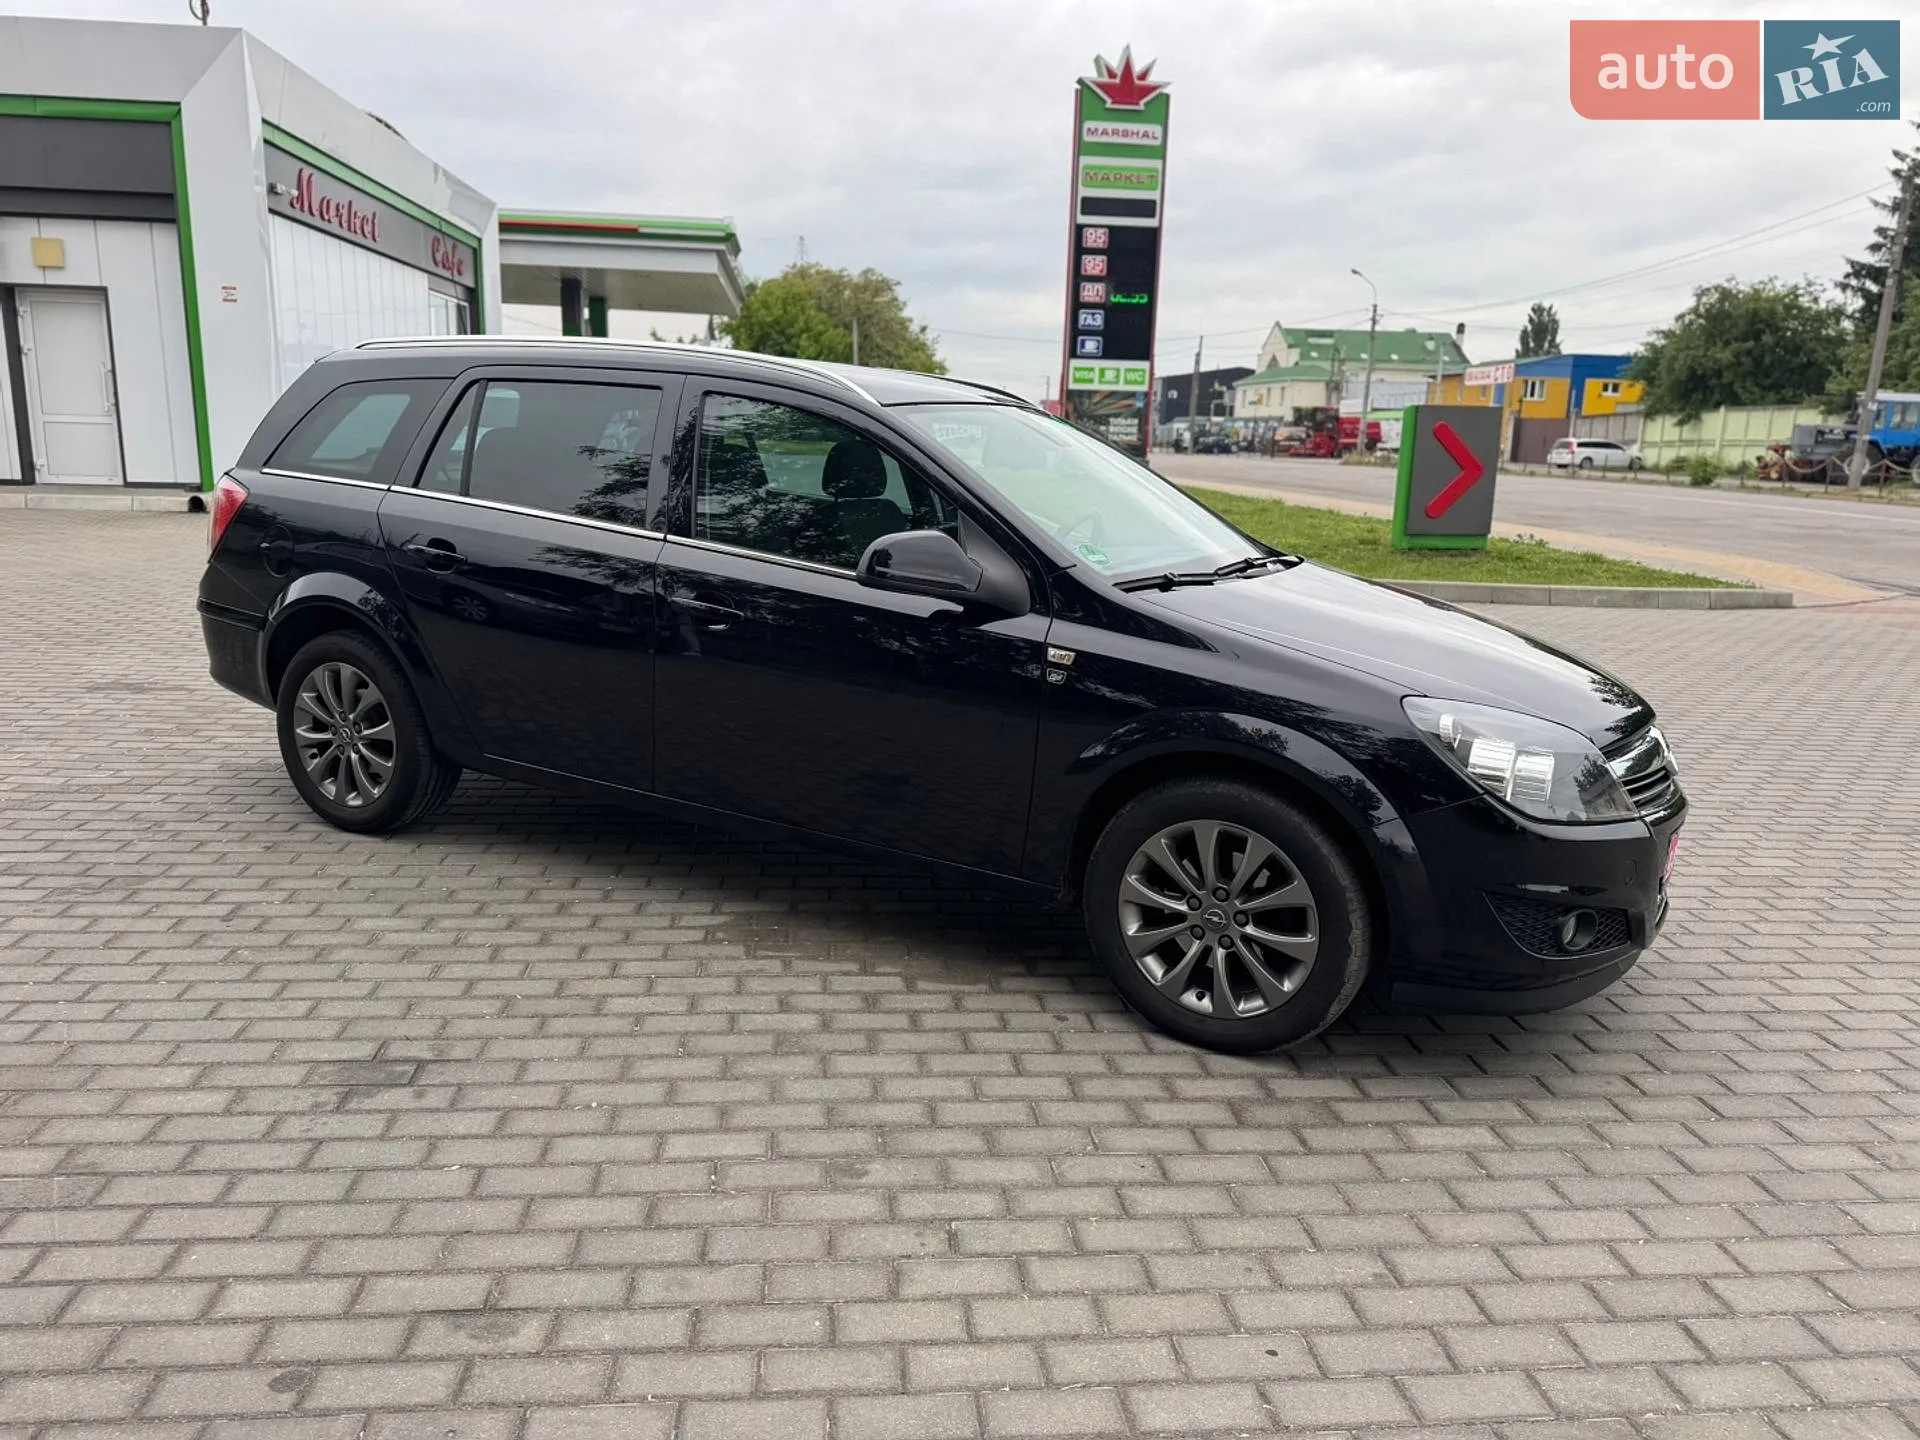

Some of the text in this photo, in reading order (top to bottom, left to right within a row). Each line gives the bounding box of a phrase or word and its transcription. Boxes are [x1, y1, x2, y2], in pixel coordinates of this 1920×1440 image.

[1086, 126, 1159, 140] MARSHAL
[289, 168, 381, 243] Market
[1086, 229, 1105, 243] 95
[1085, 256, 1103, 270] 95
[1080, 313, 1102, 326] ГАЗ
